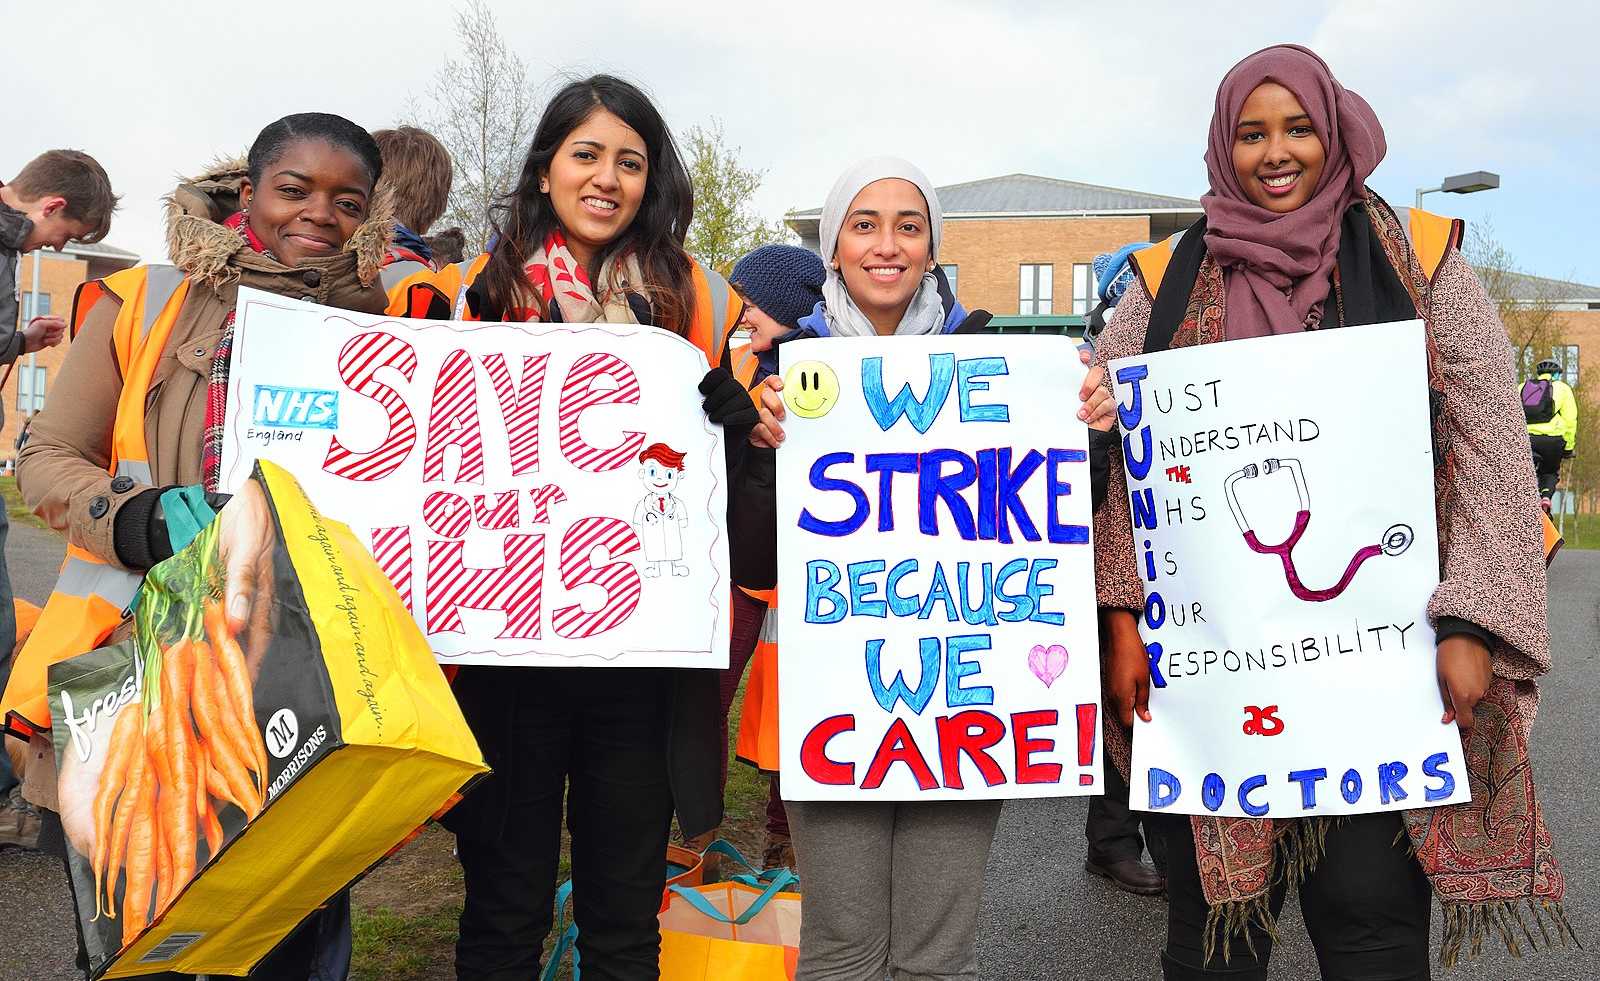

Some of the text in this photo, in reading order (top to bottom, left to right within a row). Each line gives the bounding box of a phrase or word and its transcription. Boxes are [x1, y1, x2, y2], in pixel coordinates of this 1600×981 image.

[252, 387, 334, 425] NHS
[861, 352, 1009, 434] WE
[247, 428, 303, 446] England
[798, 447, 1090, 544] STRIKE
[1165, 464, 1193, 484] THE
[423, 484, 567, 538] our
[307, 524, 341, 563] again
[331, 563, 360, 593] and
[804, 558, 1065, 626] BECAUSE
[335, 594, 365, 641] again
[354, 642, 378, 677] and
[865, 634, 994, 715] WE
[270, 714, 294, 753] M
[800, 703, 1097, 790] CARE!
[267, 724, 327, 800] MORRISONS
[1148, 752, 1456, 817] DOCTORS
